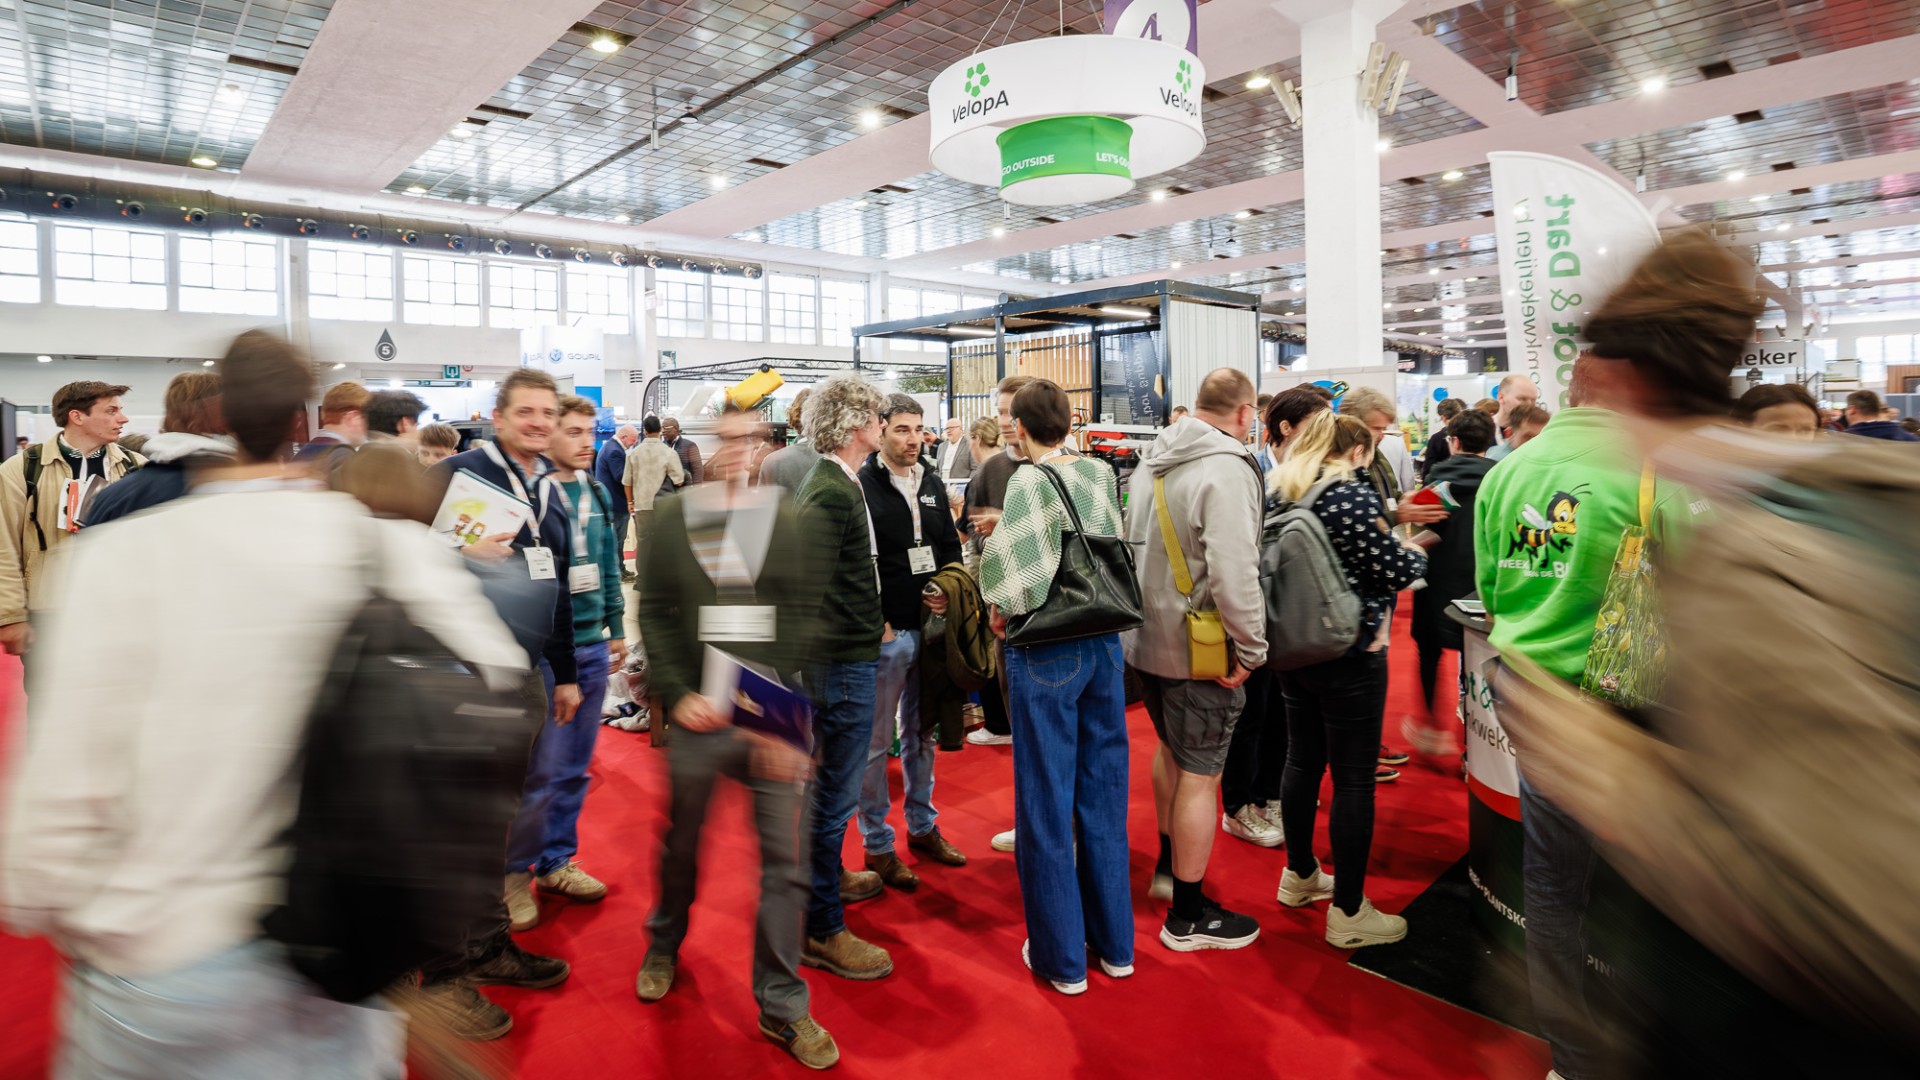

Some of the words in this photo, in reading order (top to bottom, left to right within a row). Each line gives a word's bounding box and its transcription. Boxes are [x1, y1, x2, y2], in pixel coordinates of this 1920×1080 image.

[952, 90, 1009, 124] VelopA
[1012, 154, 1055, 171] OUTSIDE
[1096, 152, 1118, 164] LET'S
[381, 345, 390, 355] 5
[568, 352, 601, 361] GOUPIL
